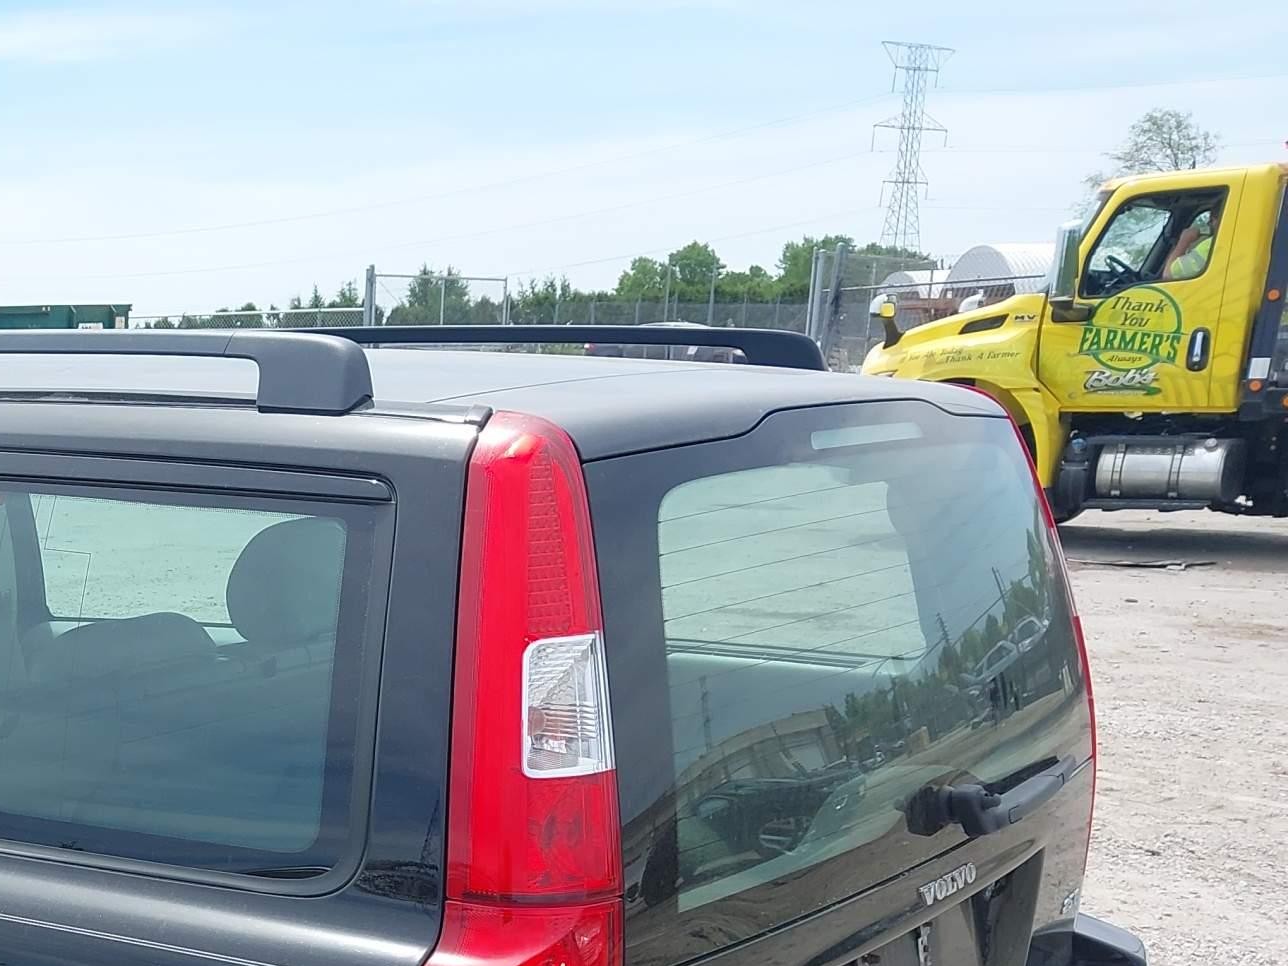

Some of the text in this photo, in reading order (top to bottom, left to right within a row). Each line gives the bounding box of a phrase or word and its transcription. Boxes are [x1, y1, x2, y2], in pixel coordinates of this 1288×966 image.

[1110, 296, 1168, 313] Thank
[1121, 312, 1151, 328] You
[1079, 327, 1182, 364] FARMER'S
[945, 354, 972, 363] Thank
[1107, 354, 1143, 363] Always
[1084, 369, 1160, 390] Bob's
[918, 862, 977, 906] VOLVO
